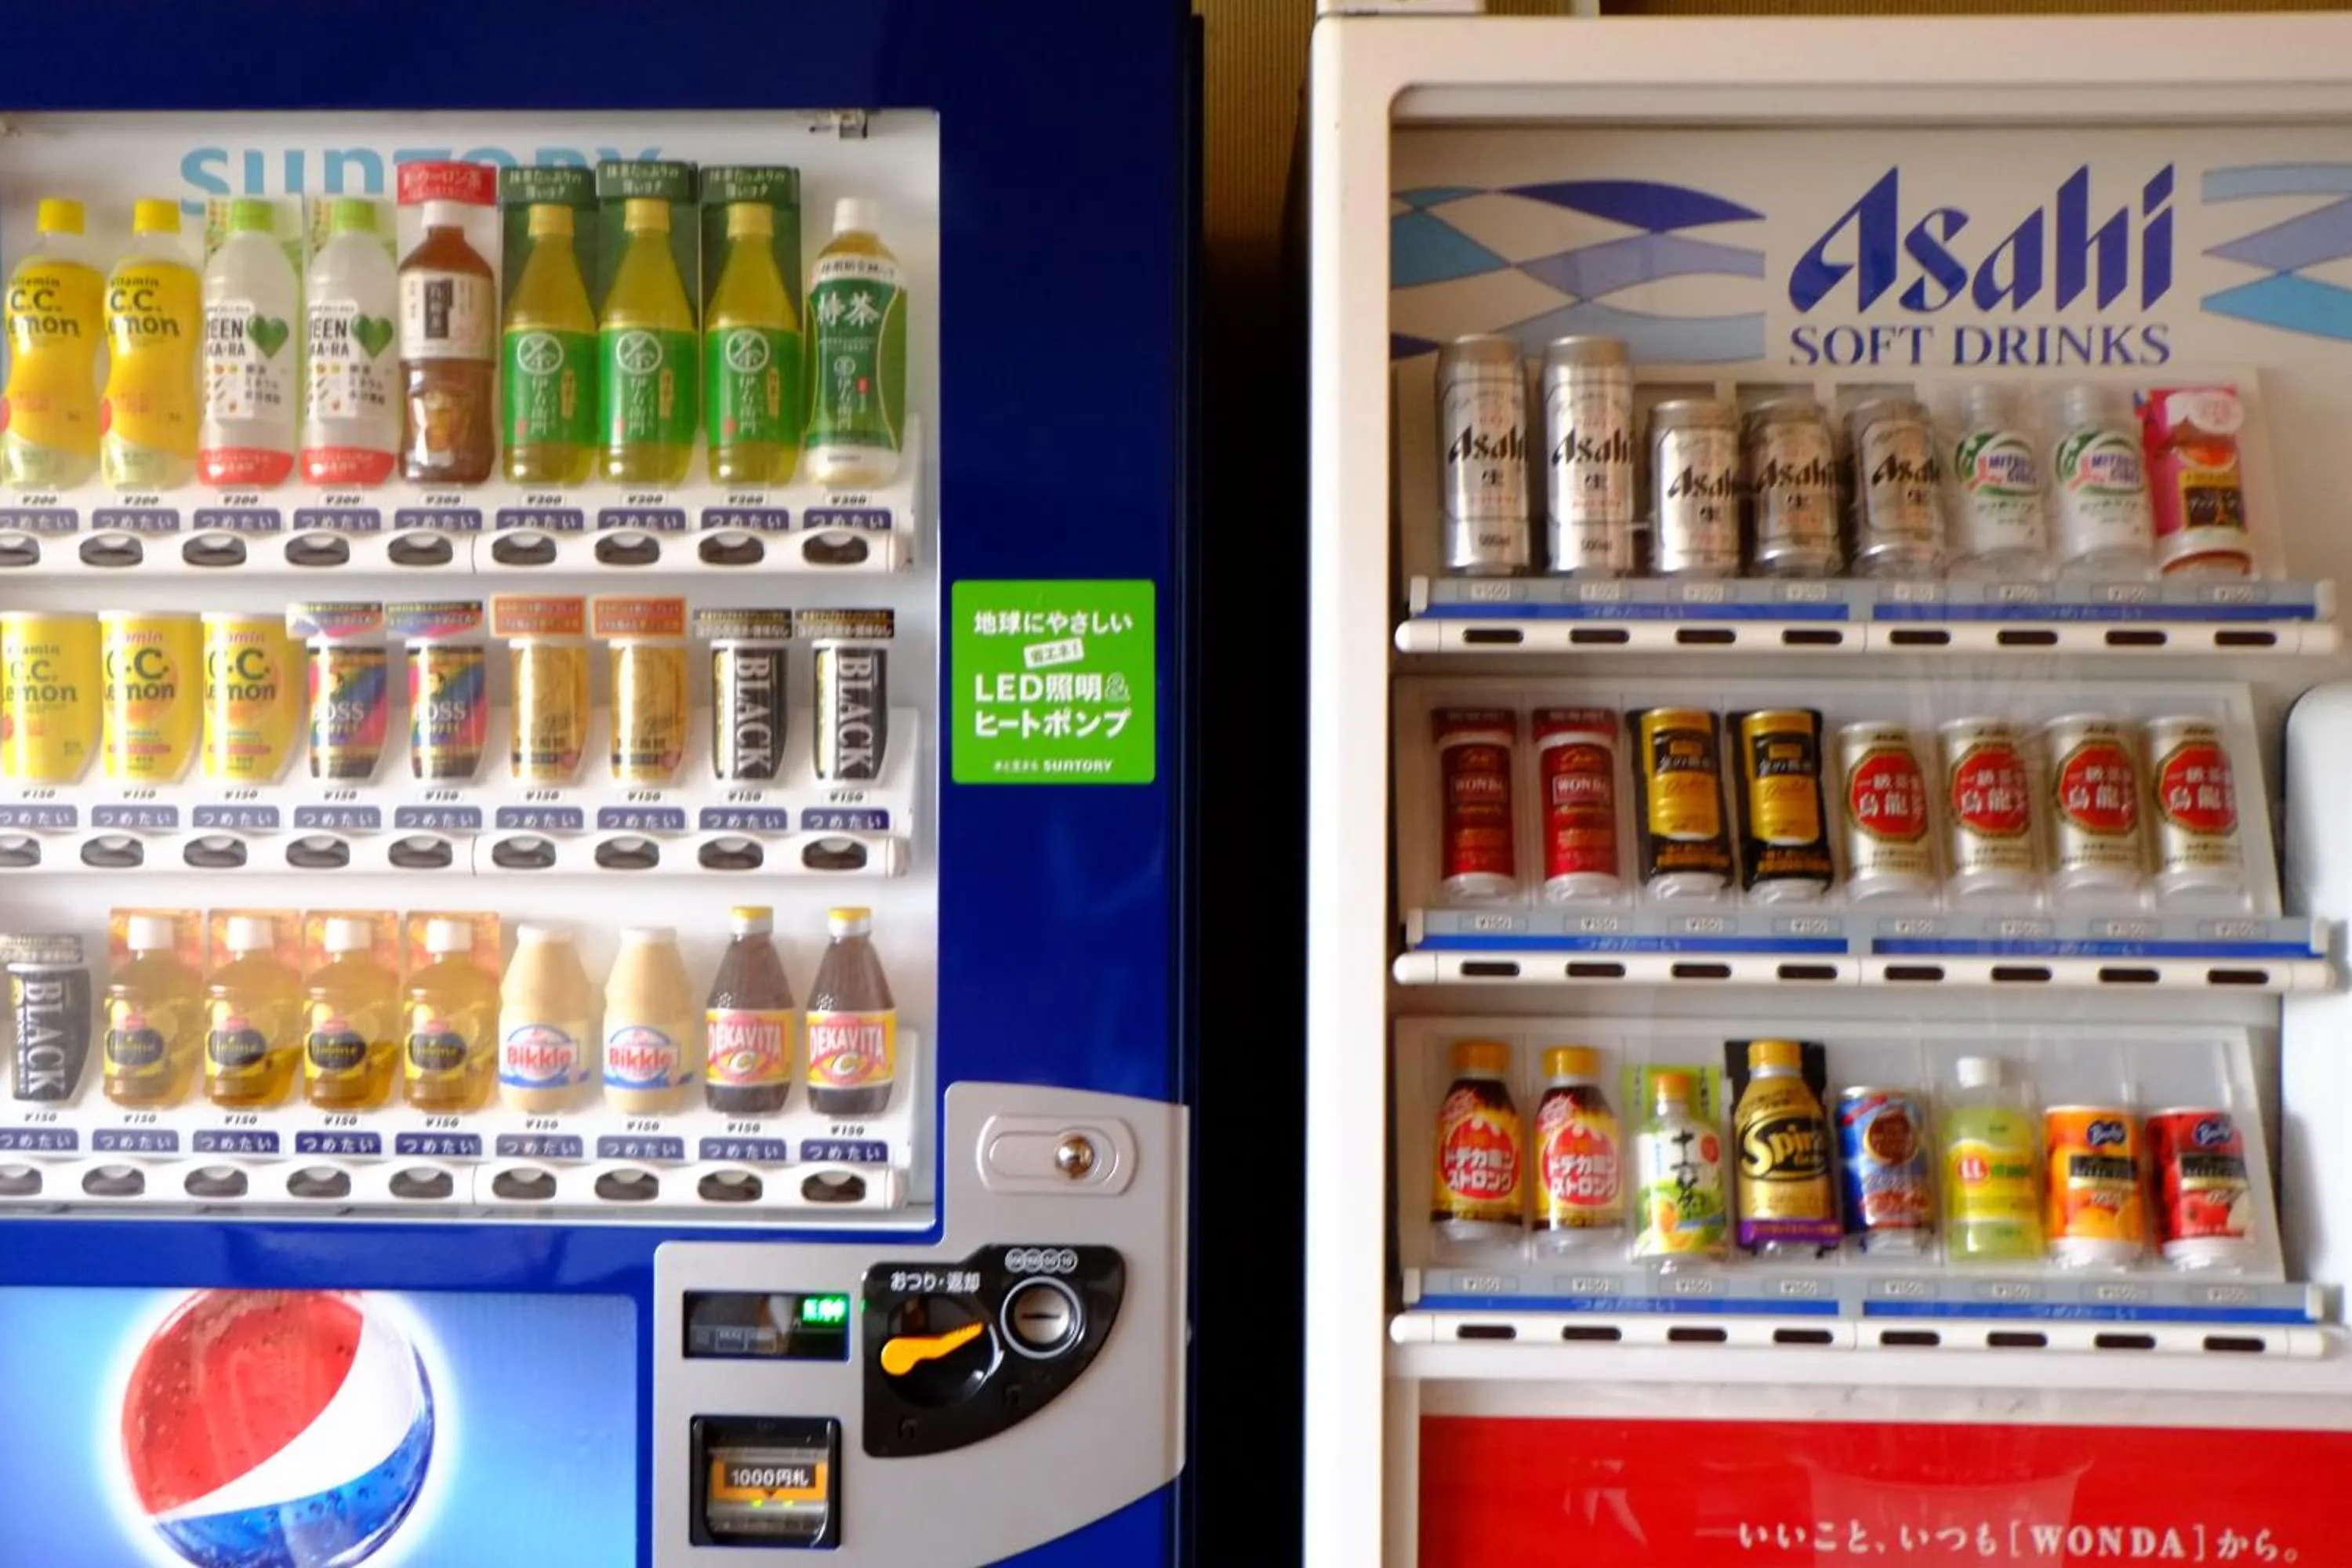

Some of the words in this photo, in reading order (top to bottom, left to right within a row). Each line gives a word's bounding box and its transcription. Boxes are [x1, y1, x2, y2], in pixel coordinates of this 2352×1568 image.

[1788, 162, 2174, 314] Asahi
[817, 290, 880, 329] 特茶
[1790, 323, 1934, 366] SOFT
[1954, 323, 2172, 367] DRINKS
[974, 609, 1134, 637] 地球にやさしい
[975, 672, 1131, 704] LED照明&
[736, 656, 771, 775] BLACK
[838, 656, 873, 775] BLACK
[975, 706, 1132, 739] ヒートポンプ
[1044, 758, 1113, 773] SUNTORY
[100, 811, 172, 826] つめたい
[199, 811, 274, 826] つめたい
[301, 811, 374, 826] つめたい
[402, 811, 475, 827] つめたい
[503, 812, 576, 828] つめたい
[603, 812, 678, 828] つめたい
[706, 812, 780, 828] つめたい
[808, 812, 882, 828] つめたい
[26, 981, 67, 1095] BLACK
[707, 1020, 782, 1057] DEKAVITA
[809, 1022, 884, 1058] DEKAVITA
[506, 1046, 572, 1068] Bikkle
[608, 1046, 673, 1068] Bikkle
[728, 1051, 754, 1073] C
[830, 1051, 857, 1074] C
[100, 1134, 173, 1151] つめたい
[200, 1135, 274, 1152] つめたい
[302, 1137, 376, 1152] つめたい
[403, 1138, 477, 1154] つめたい
[503, 1140, 576, 1156] つめたい
[603, 1141, 677, 1157] つめたい
[706, 1143, 779, 1160] つめたい
[808, 1144, 882, 1160] つめたい
[890, 1271, 981, 1294] おつり・返却
[730, 1466, 810, 1490] 1000円札
